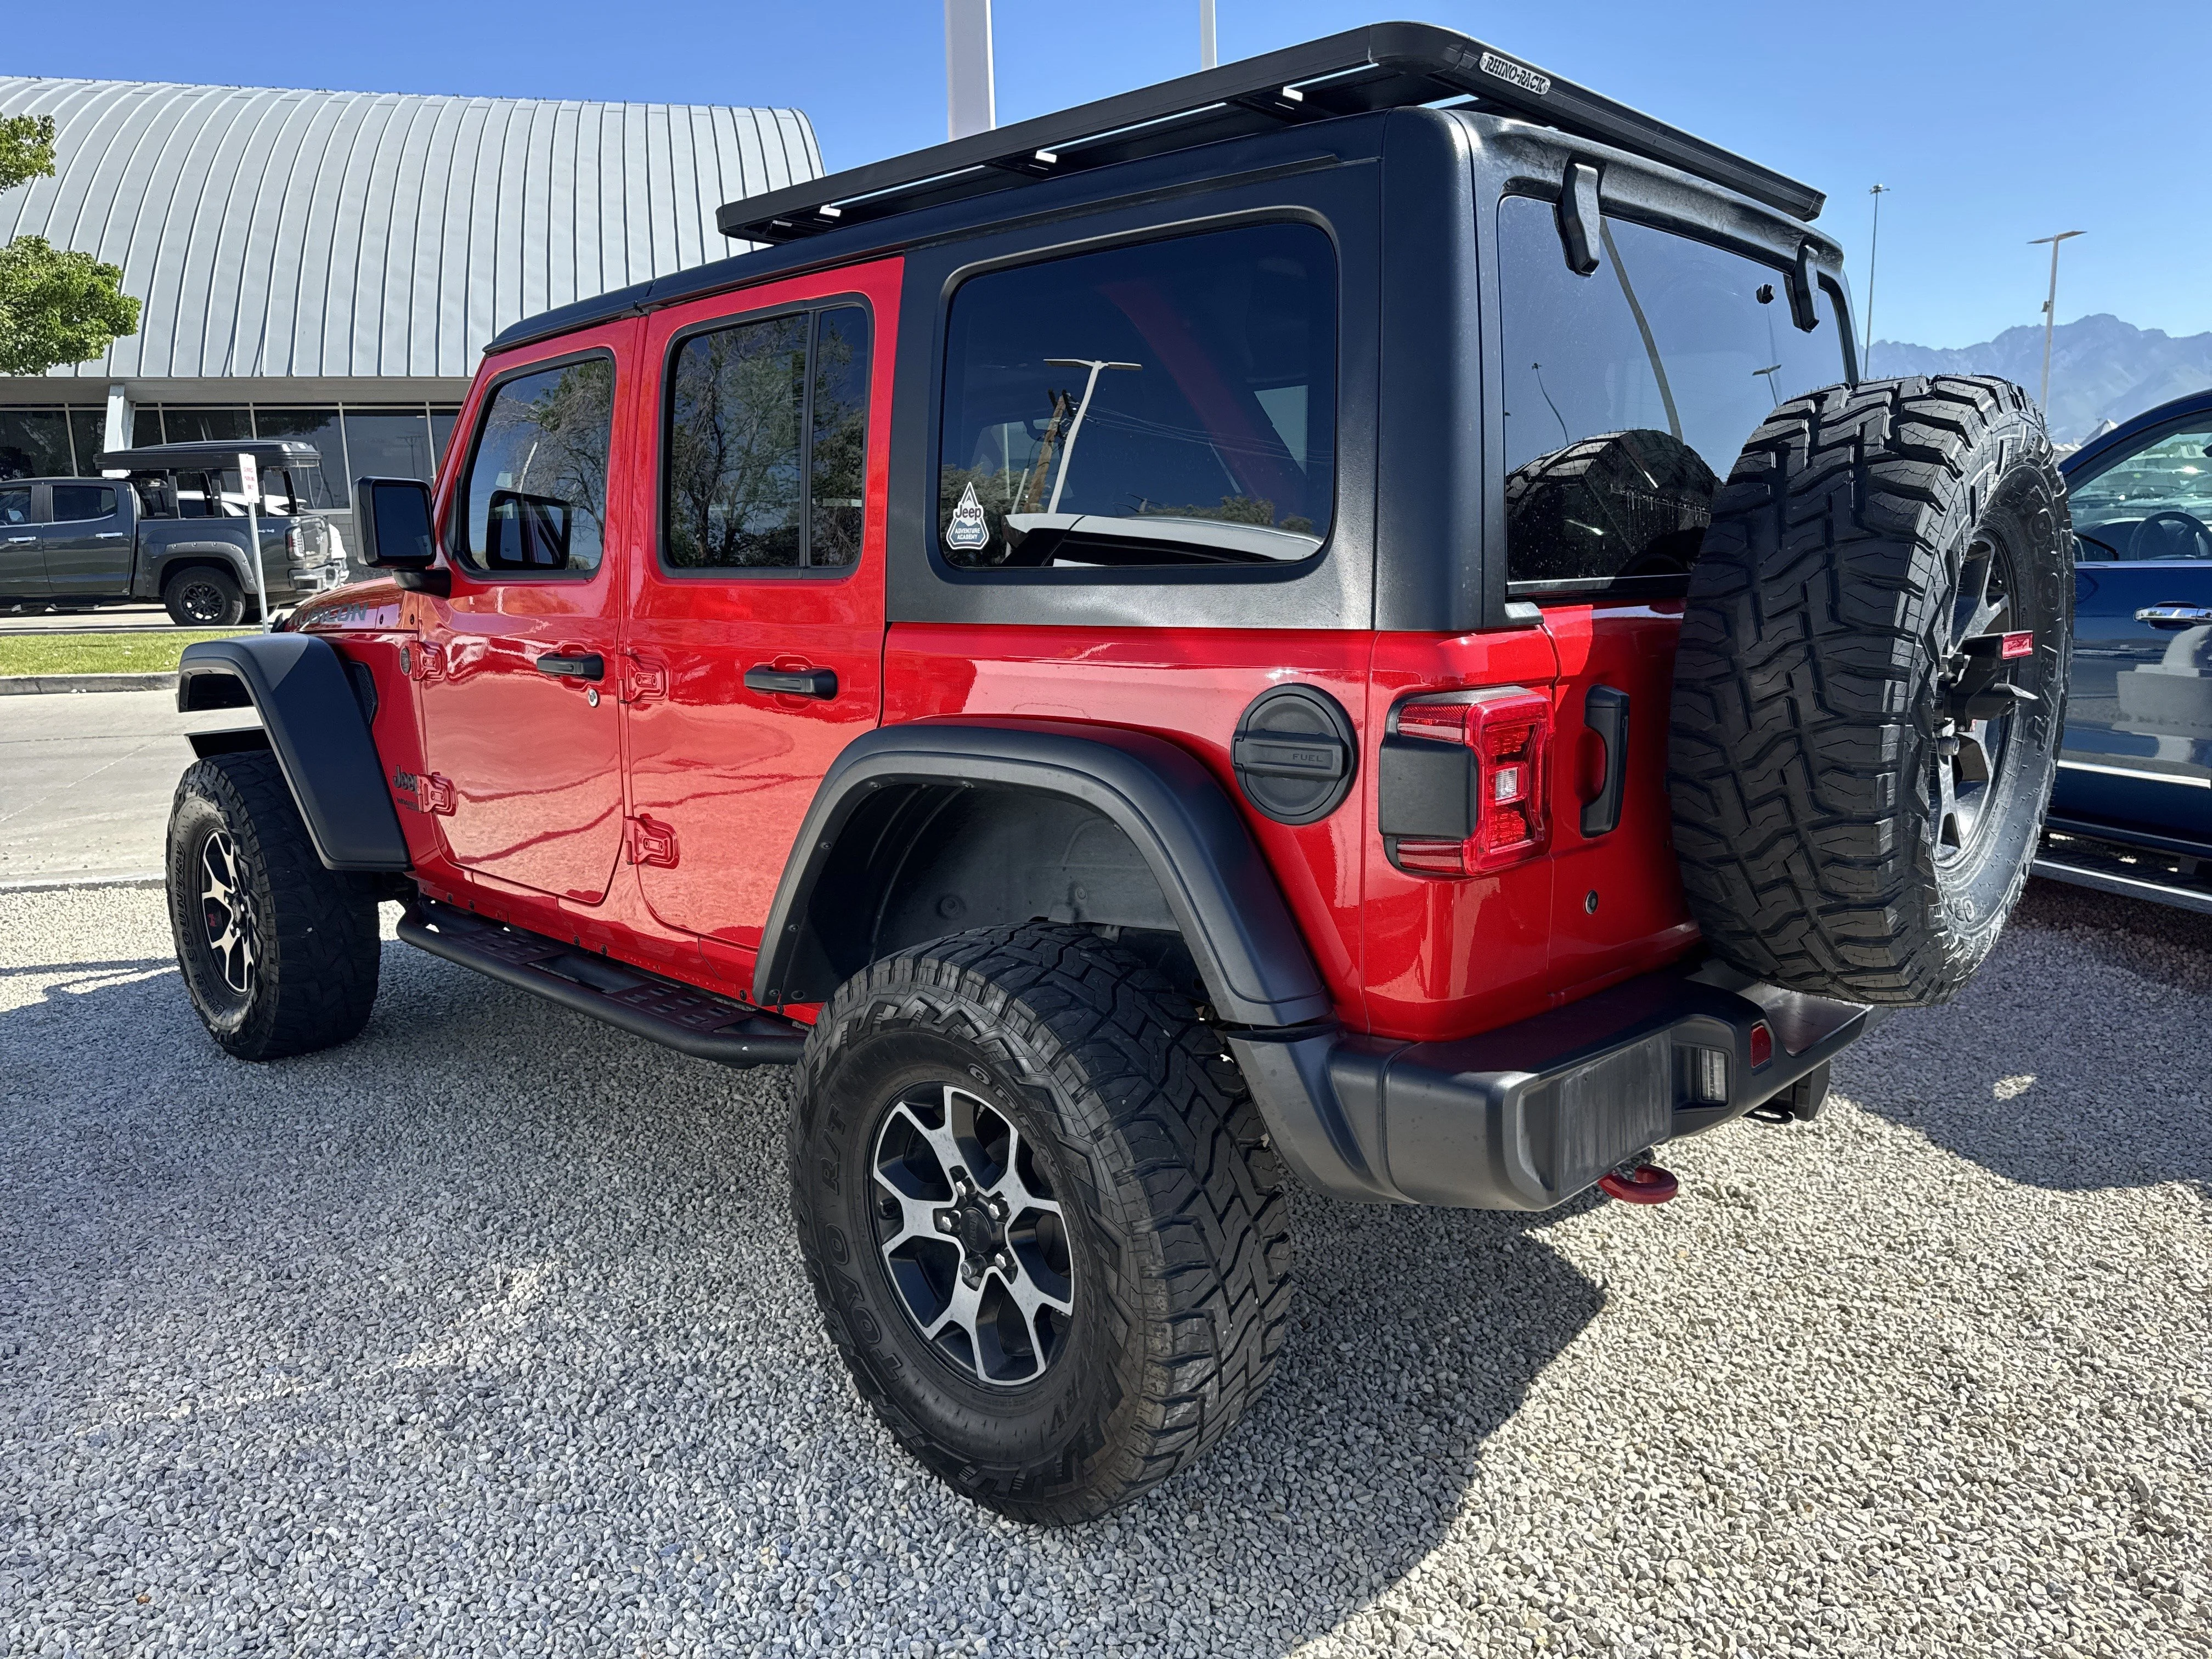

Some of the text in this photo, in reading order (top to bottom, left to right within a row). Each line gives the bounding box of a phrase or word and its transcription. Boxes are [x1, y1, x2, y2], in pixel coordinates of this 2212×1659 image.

[1484, 55, 1546, 93] RHINO-RACK
[955, 504, 981, 521] Jeep
[288, 603, 369, 627] RUBICON
[1292, 752, 1323, 763] FUEL
[172, 839, 199, 964] COUNTRY
[821, 1102, 904, 1383] TOYO R/T
